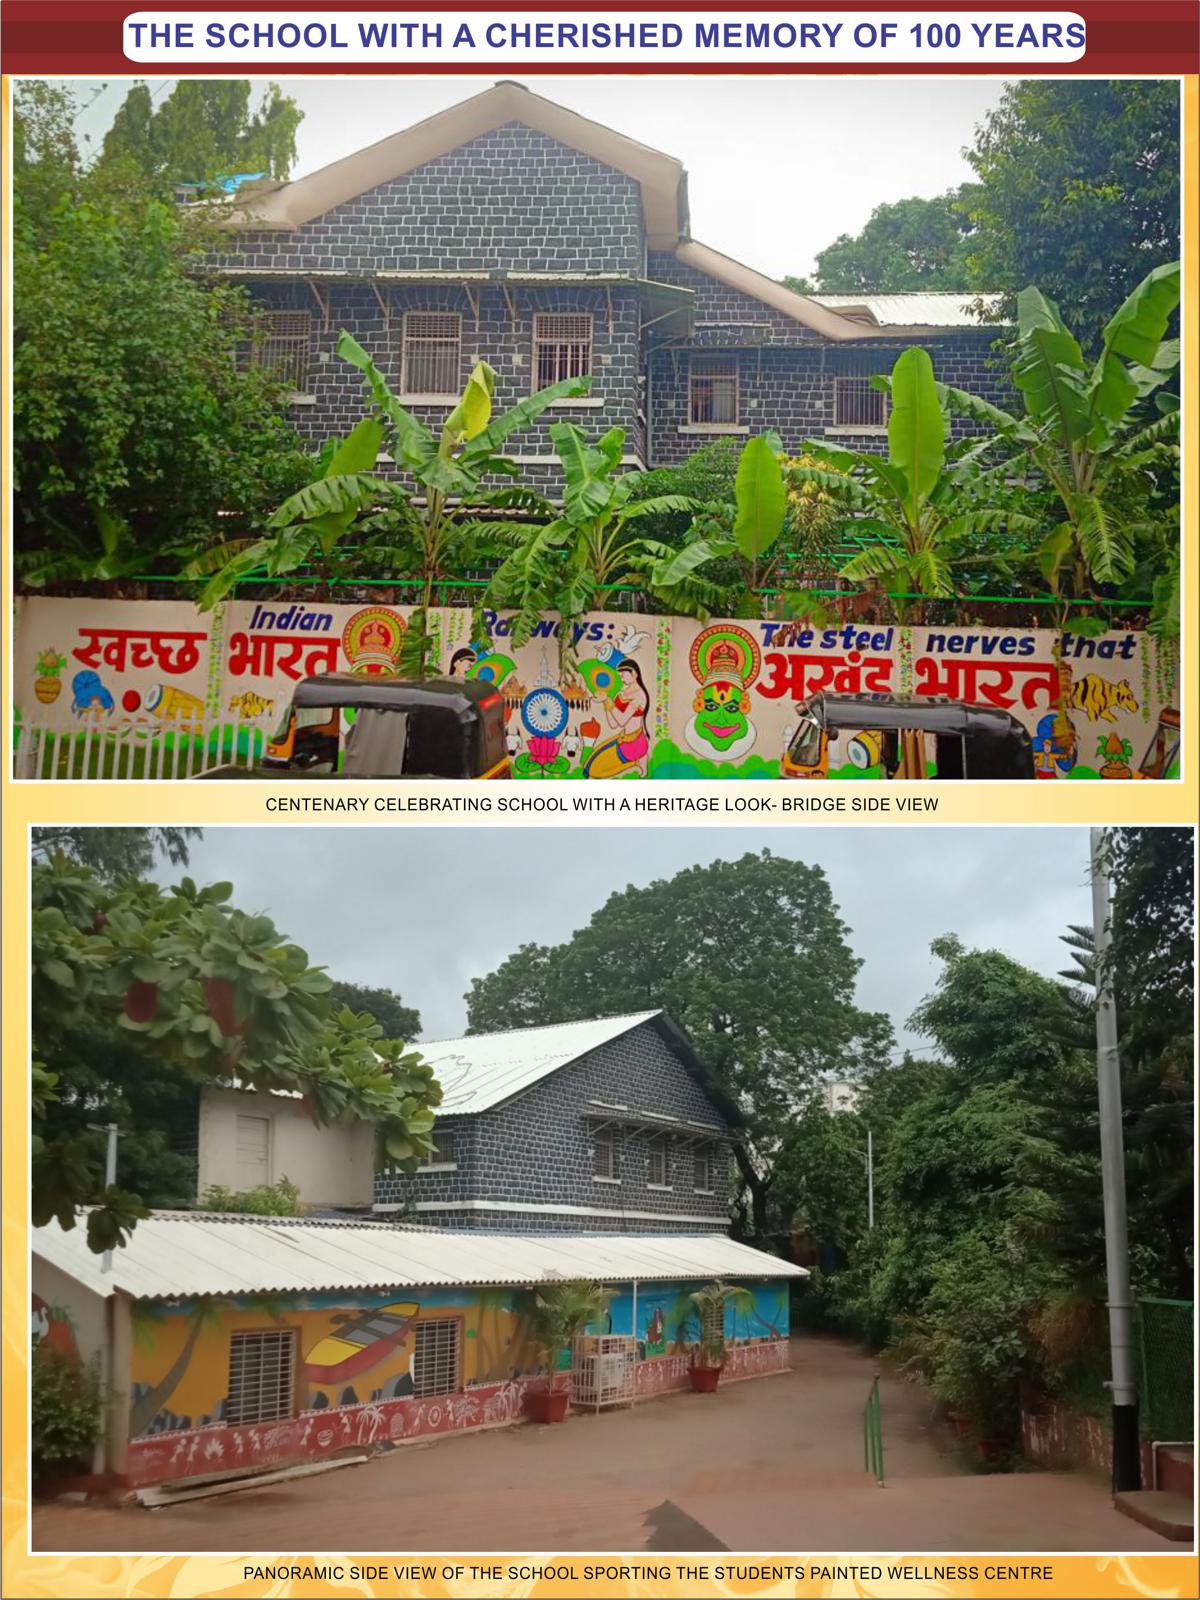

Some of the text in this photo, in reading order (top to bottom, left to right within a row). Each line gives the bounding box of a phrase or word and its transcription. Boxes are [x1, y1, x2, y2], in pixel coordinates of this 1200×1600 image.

[249, 605, 333, 631] Indian
[72, 628, 341, 681] स्वच्छ भारत
[760, 622, 1137, 660] The steel nerves that
[915, 657, 1062, 710] भारत
